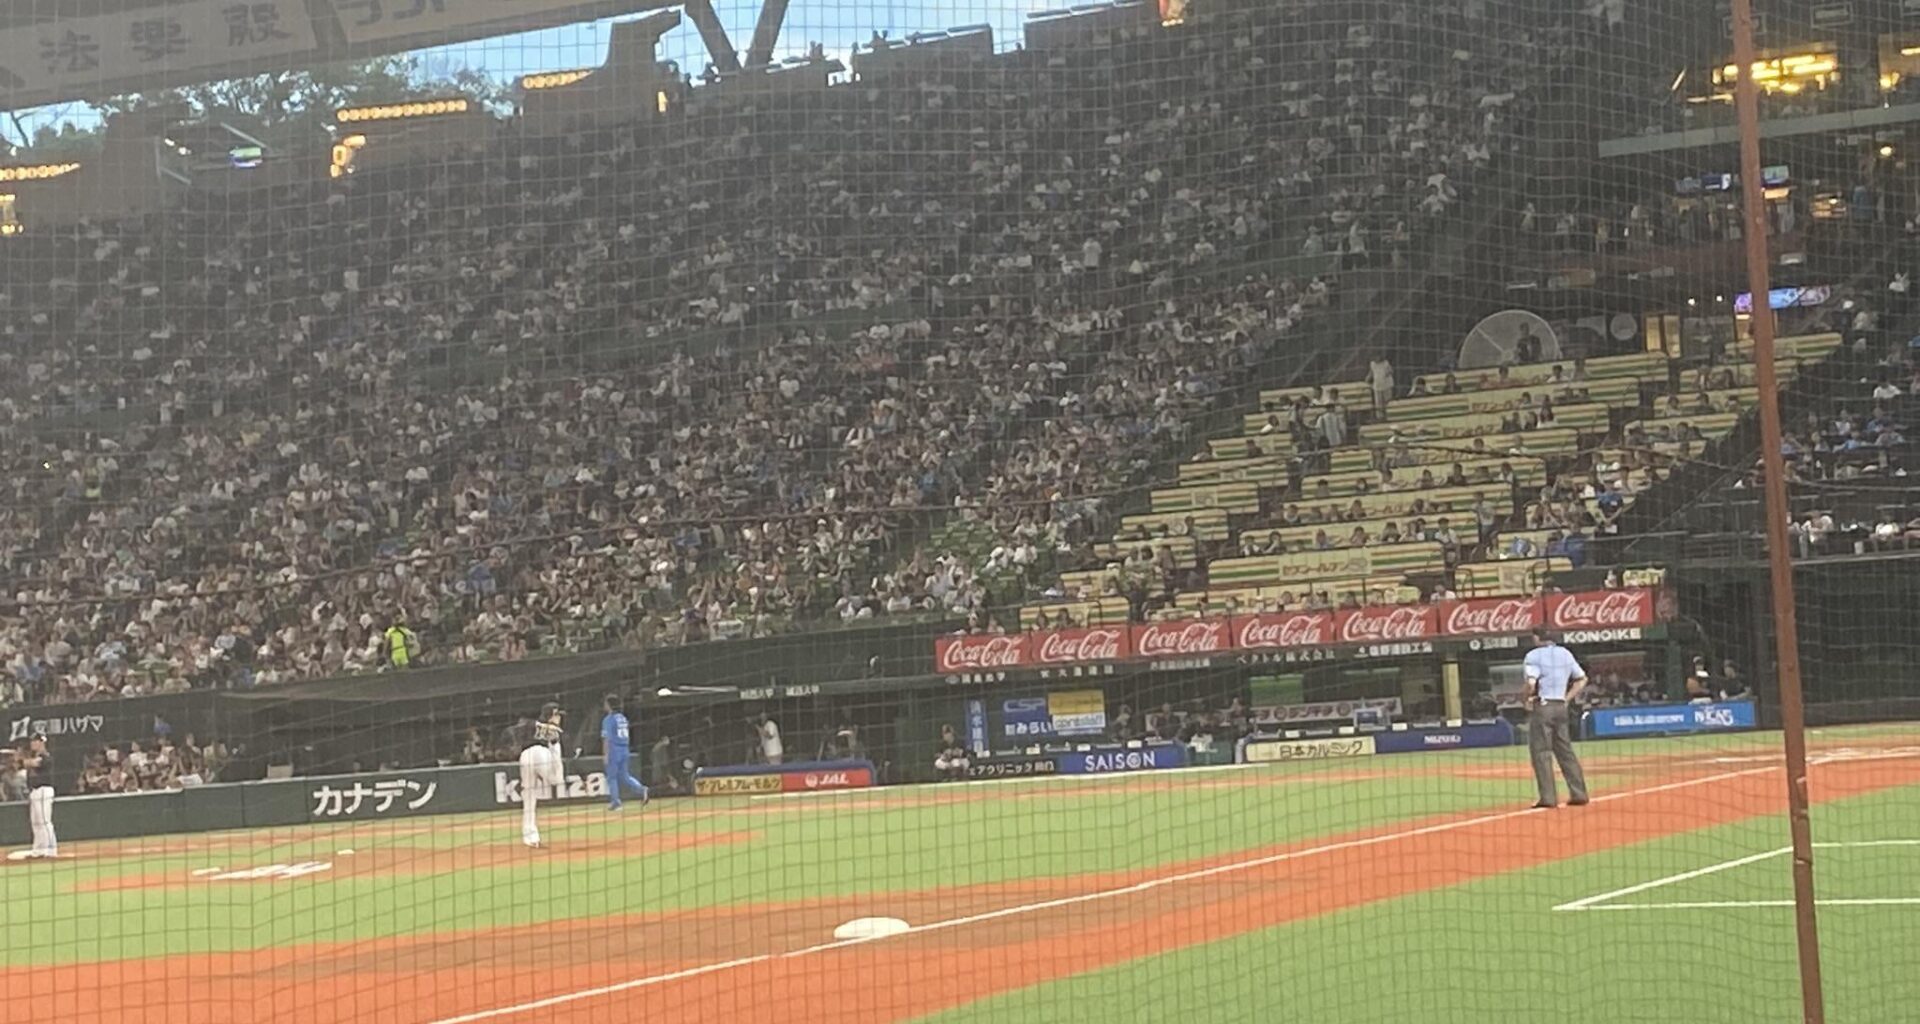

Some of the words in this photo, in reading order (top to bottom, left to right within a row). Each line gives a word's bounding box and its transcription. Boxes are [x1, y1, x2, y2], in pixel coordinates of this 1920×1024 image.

[1343, 607, 1429, 641] Coca-Cola
[1447, 600, 1536, 634] Coca-Cola
[1554, 591, 1645, 627] Coca-Cola
[1040, 630, 1121, 662] Coca-Cola
[1139, 622, 1222, 656] Coca-Cola
[1240, 615, 1323, 648] Coca-Cola
[1562, 627, 1641, 643] KONOIKE
[943, 637, 1024, 669] Coca-Cola
[1085, 751, 1155, 772] SAISON
[313, 779, 437, 816] カナデン
